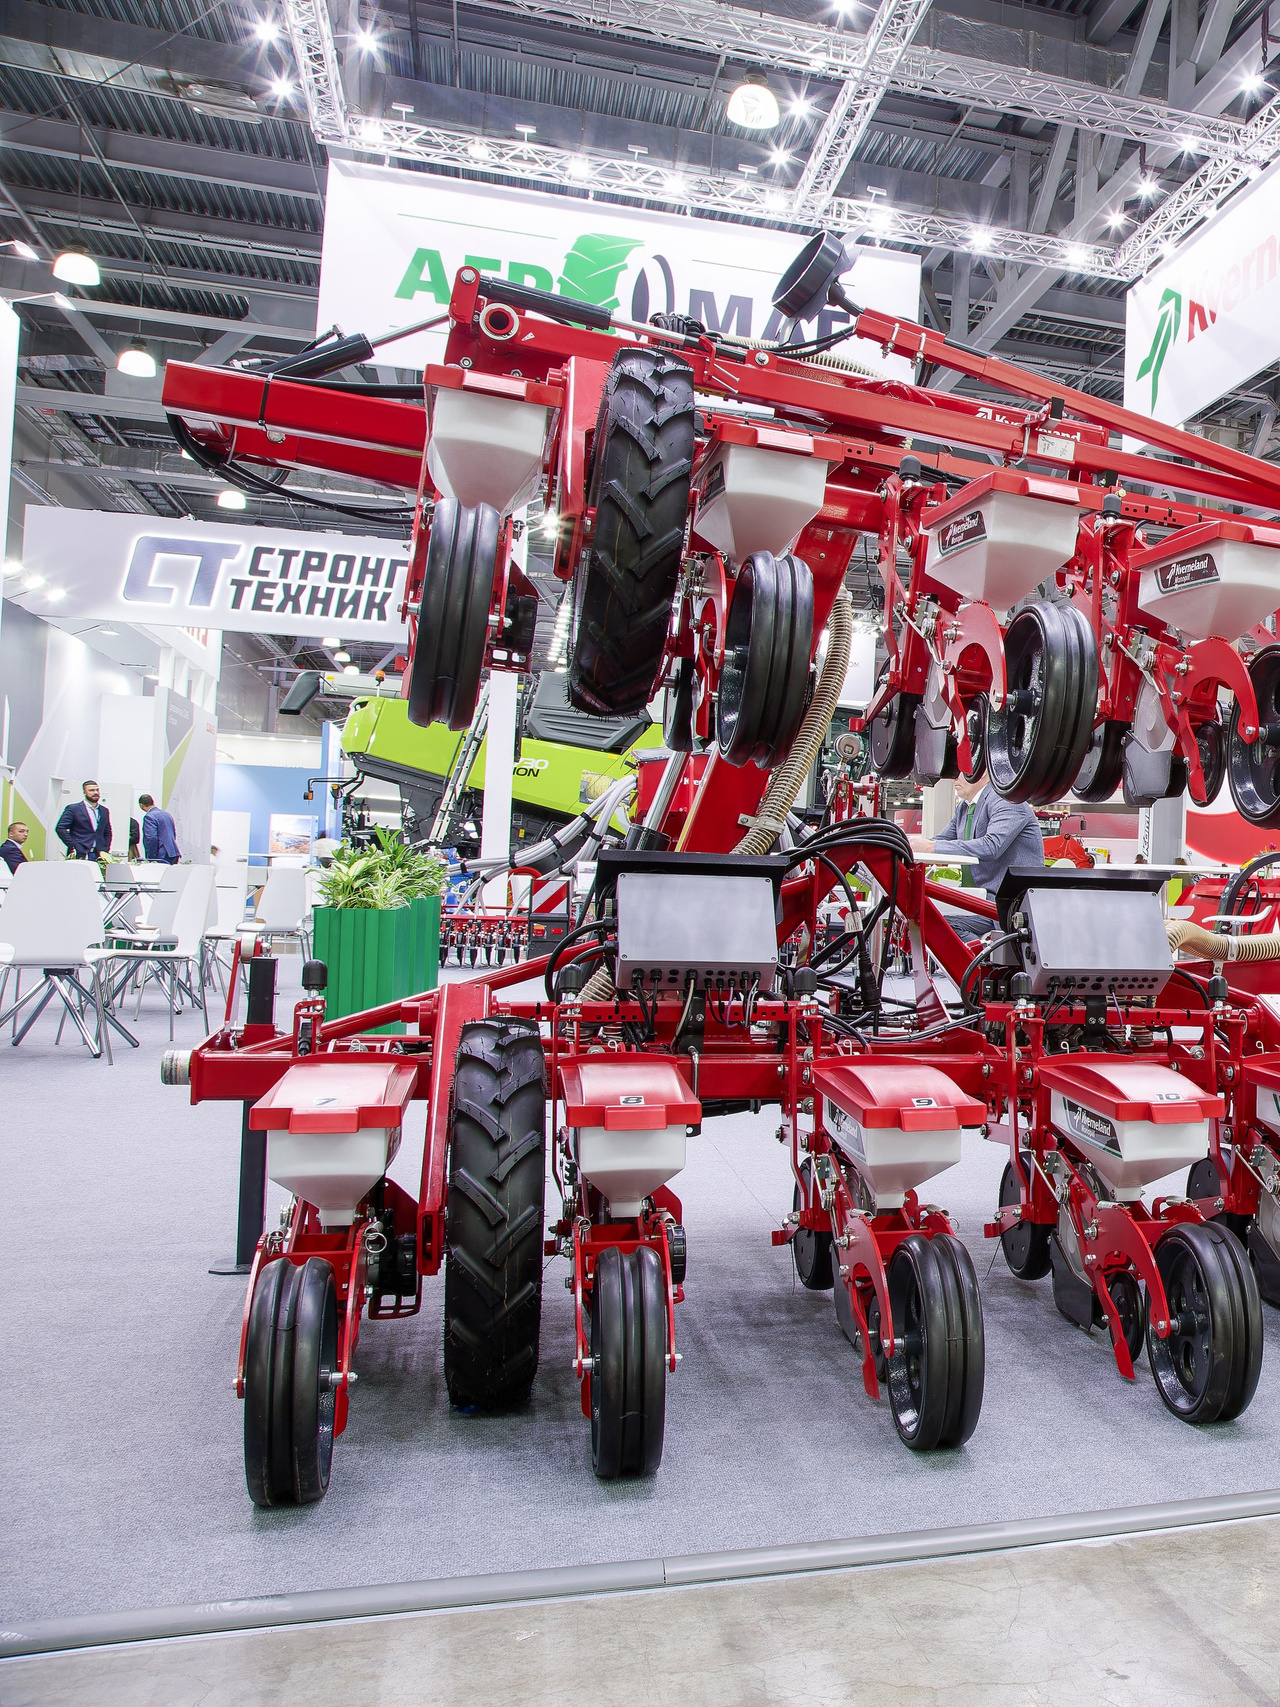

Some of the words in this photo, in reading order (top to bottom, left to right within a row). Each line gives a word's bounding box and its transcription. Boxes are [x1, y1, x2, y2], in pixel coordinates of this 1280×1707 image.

[248, 546, 408, 588] СТРОНГ
[1176, 556, 1209, 576] Kverneland
[230, 578, 392, 622] ТЕХНИК
[316, 1097, 338, 1106] 7
[622, 1096, 643, 1104] 8
[915, 1098, 933, 1106] 9
[1156, 1093, 1181, 1101] 10
[1081, 1111, 1111, 1137] Kverneland
